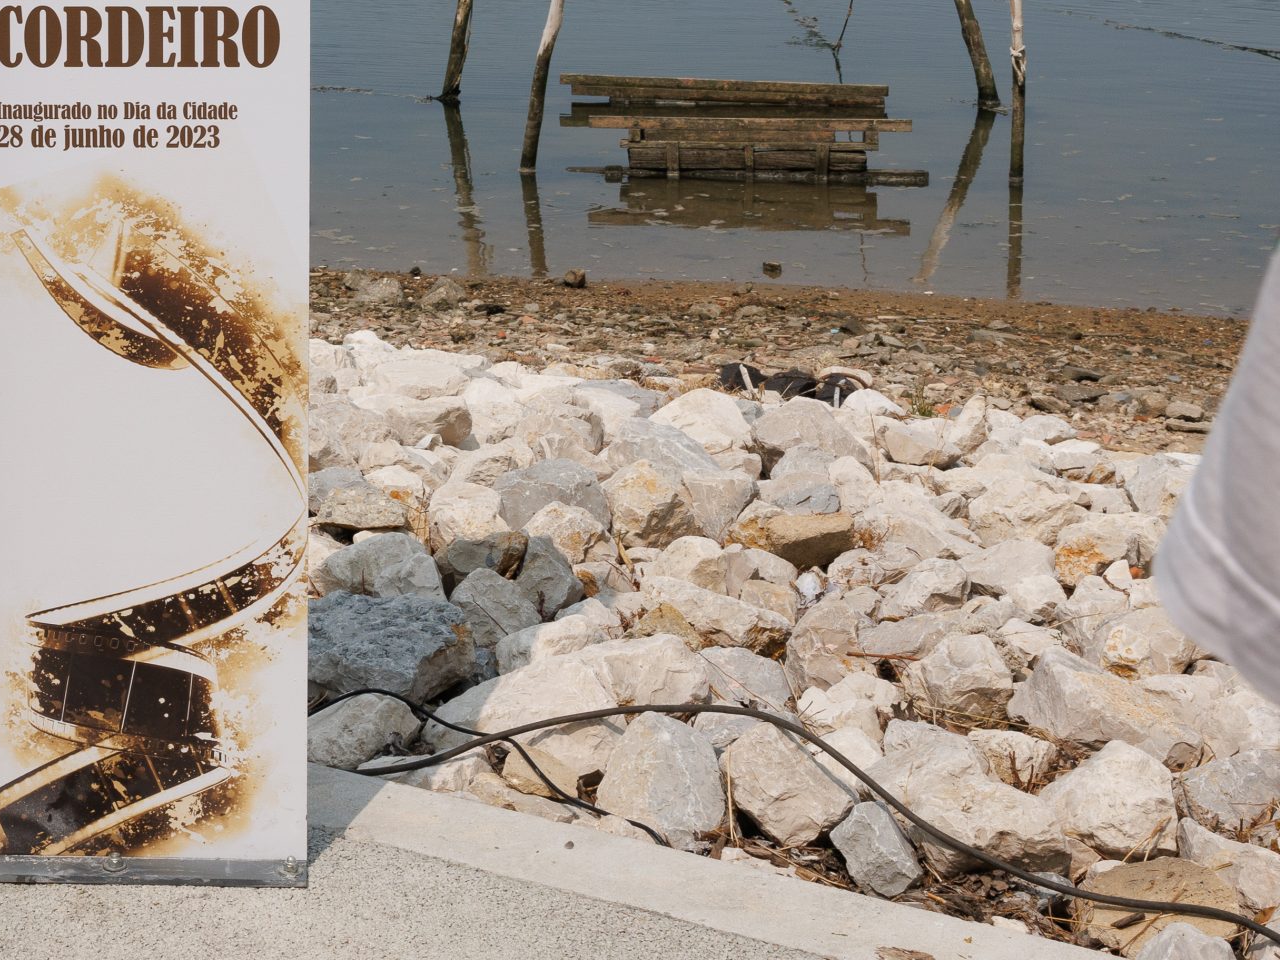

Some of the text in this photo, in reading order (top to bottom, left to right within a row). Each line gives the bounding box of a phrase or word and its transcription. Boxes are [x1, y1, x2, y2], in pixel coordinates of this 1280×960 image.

[97, 104, 118, 120] no
[123, 101, 151, 120] Dia
[156, 101, 178, 120] da
[182, 101, 238, 120] Cidade
[30, 124, 57, 149] de
[63, 124, 126, 152] junho
[132, 124, 159, 149] de
[165, 124, 221, 149] 2023
